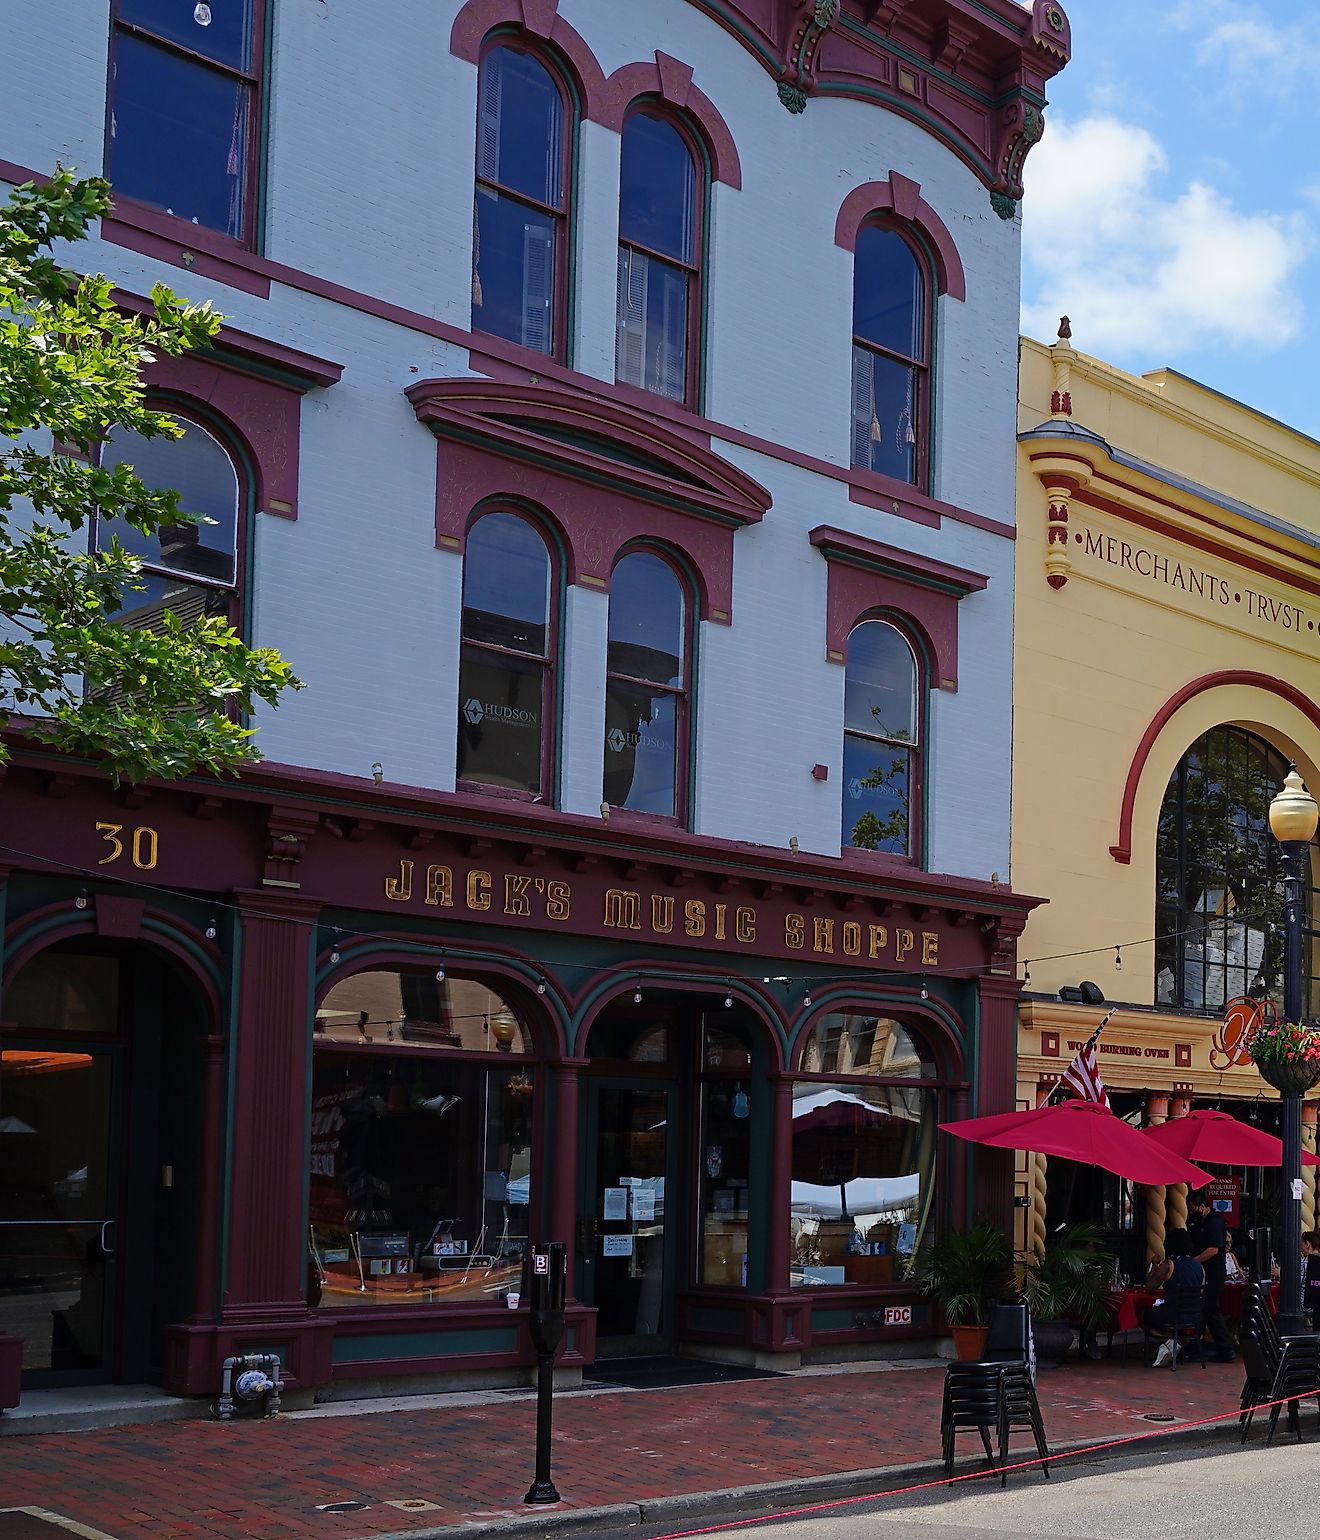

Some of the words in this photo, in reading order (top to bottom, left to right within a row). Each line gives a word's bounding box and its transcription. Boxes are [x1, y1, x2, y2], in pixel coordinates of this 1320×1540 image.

[1084, 528, 1230, 606] MERCHANTS
[1245, 588, 1304, 632] TRVST
[485, 703, 537, 724] HUDSON
[95, 821, 159, 870] 30
[385, 859, 571, 921] JACK'S
[603, 888, 757, 943] MUSIC
[784, 913, 939, 966] SHOPPE
[1100, 1044, 1142, 1057] BURNING
[1144, 1047, 1170, 1059] OVEN
[536, 1256, 546, 1268] B
[886, 1308, 910, 1323] FDC
